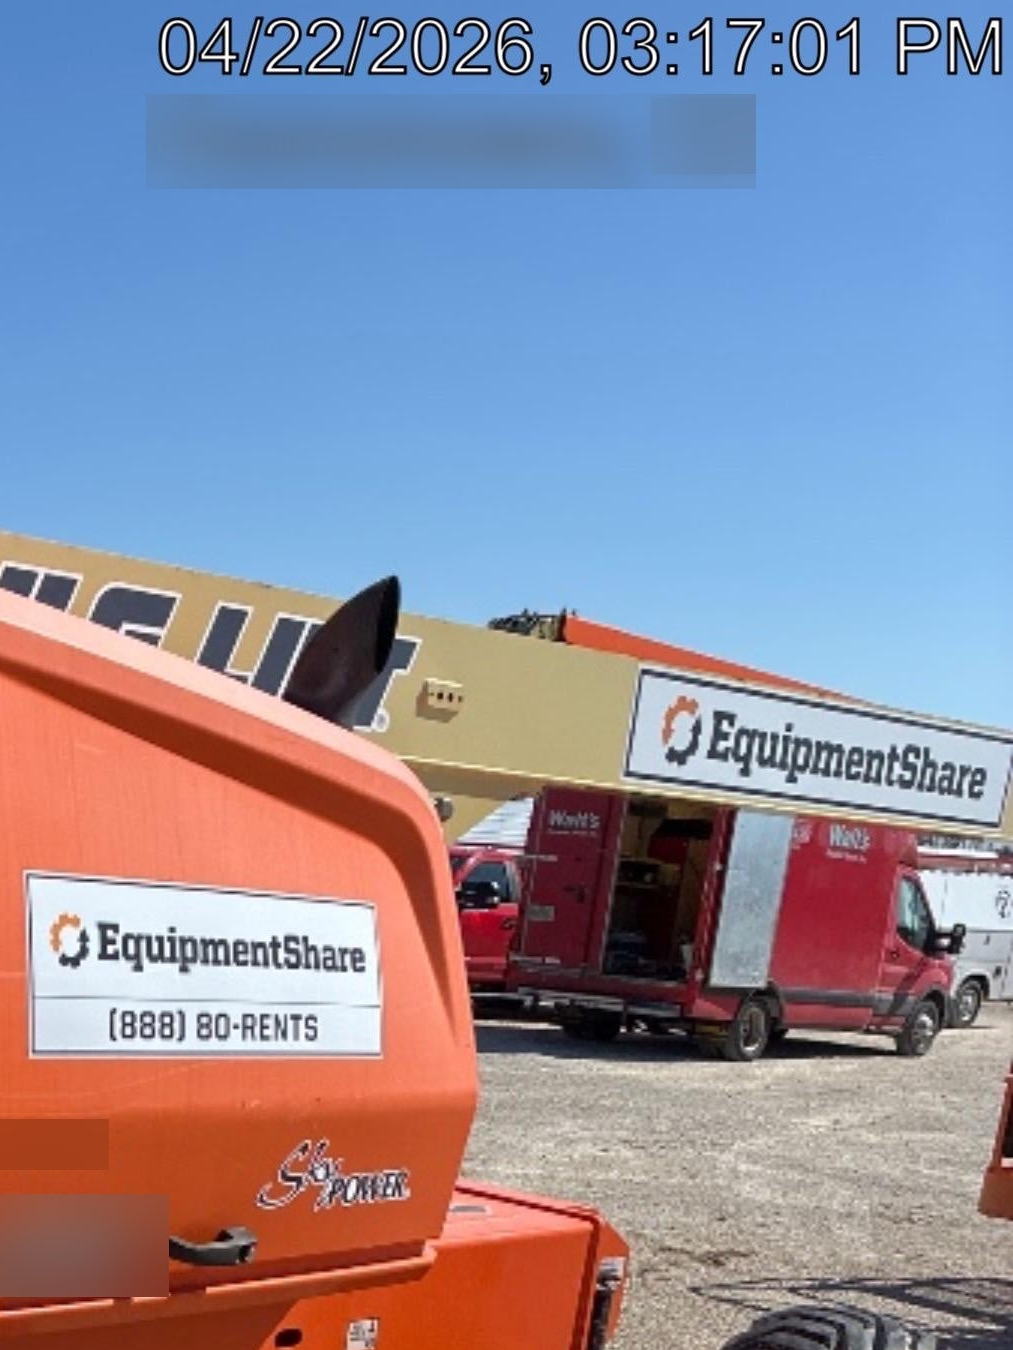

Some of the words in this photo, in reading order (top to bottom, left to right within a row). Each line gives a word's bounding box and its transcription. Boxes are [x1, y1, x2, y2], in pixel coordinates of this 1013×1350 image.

[707, 709, 987, 800] EquipmentShare
[97, 921, 366, 974] EquipmentShare
[109, 1007, 186, 1042] (888)
[196, 1012, 319, 1042] 80-RENTS
[328, 1169, 411, 1206] POWER
